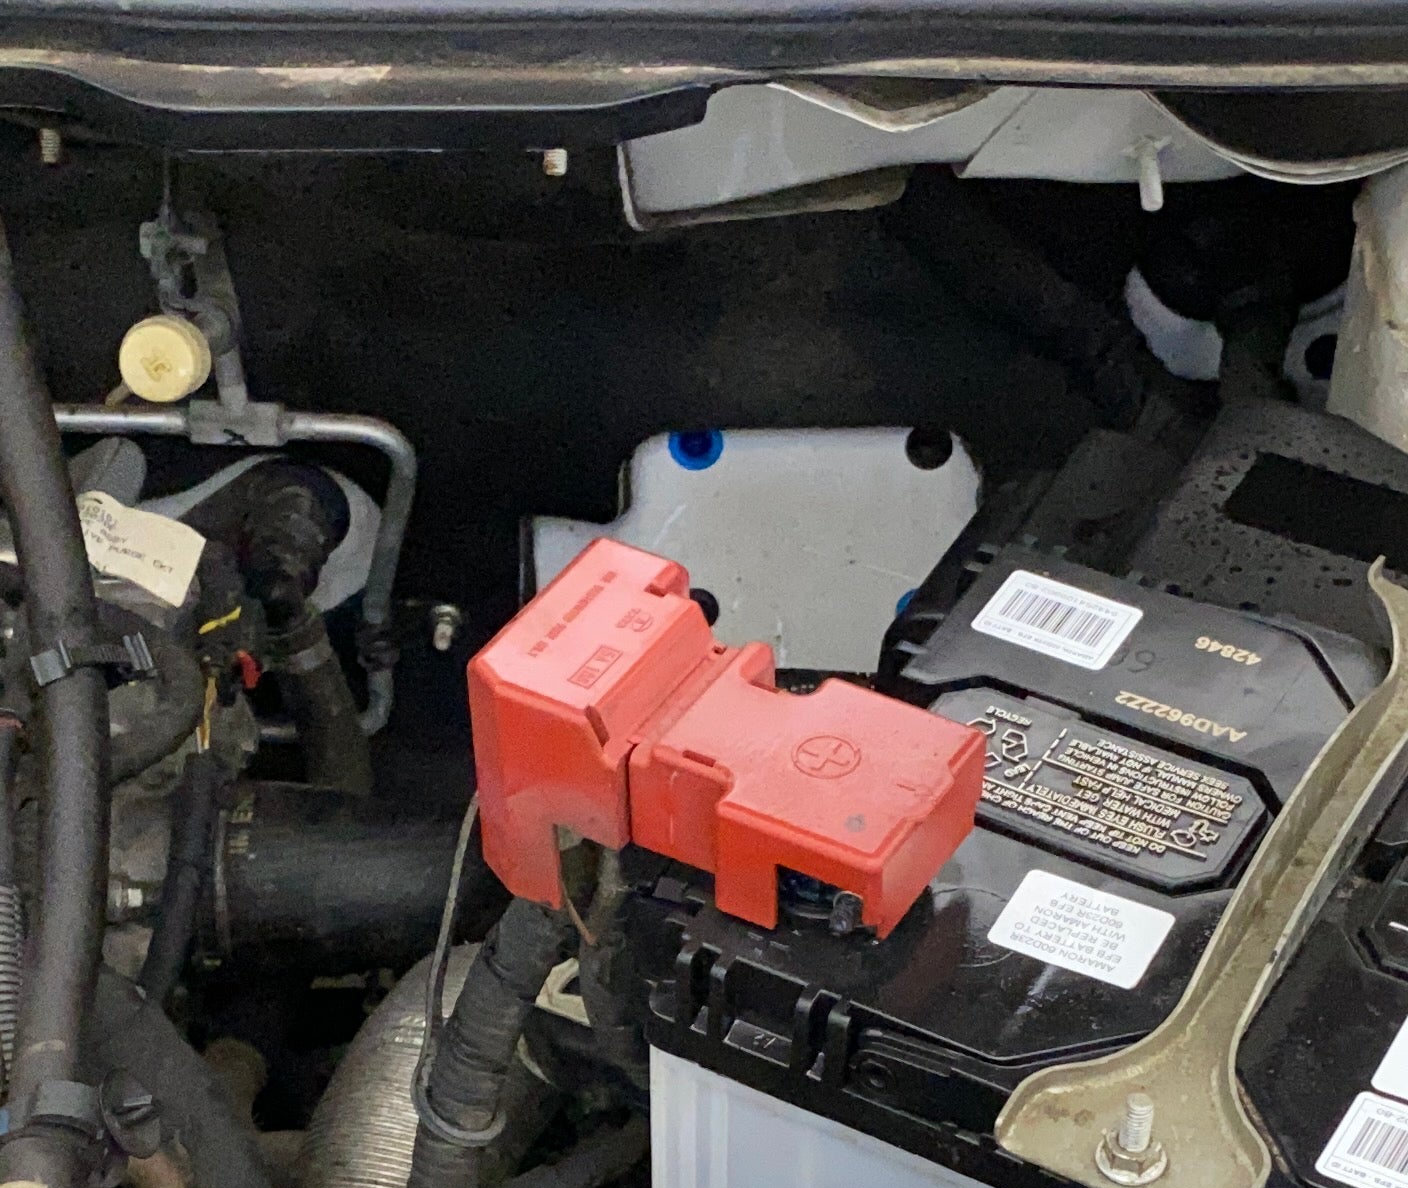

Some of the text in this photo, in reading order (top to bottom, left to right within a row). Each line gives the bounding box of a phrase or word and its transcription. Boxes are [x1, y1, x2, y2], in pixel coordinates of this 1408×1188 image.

[1193, 635, 1262, 667] 42846
[985, 705, 1032, 726] RECYCLE
[1069, 738, 1119, 761] AVAILABLE
[1057, 752, 1106, 776] STARTING
[1096, 738, 1229, 790] SEEK SERVICE ASSISTANCE
[1119, 755, 1141, 769] NOT
[1064, 746, 1234, 811] FOLLOW INSTRUCTIONS IN VEHICLE
[1105, 770, 1134, 785] JUMP
[1132, 779, 1161, 795] SAFE
[995, 787, 1023, 801] TIGHT
[1072, 774, 1180, 819] MEDICAL HELP FAST
[1075, 787, 1100, 802] GET
[1160, 789, 1183, 803] FOR
[1025, 781, 1166, 839] FLUSH EYES IMMEDIATELY
[1050, 807, 1079, 821] VENT
[1141, 811, 1172, 828] WITH
[1090, 831, 1112, 843] OUT
[1111, 839, 1140, 853] KEEP
[1126, 834, 1149, 846] NOT
[1048, 899, 1123, 929] 60D23R EFB
[1059, 890, 1120, 916] BATTERY
[1029, 915, 1118, 950] BE REPLACED
[1033, 905, 1126, 941] WITH AMARON
[1008, 932, 1116, 973] AMARON 60D23R
[1012, 922, 1122, 963] EFB BATTERY TO
